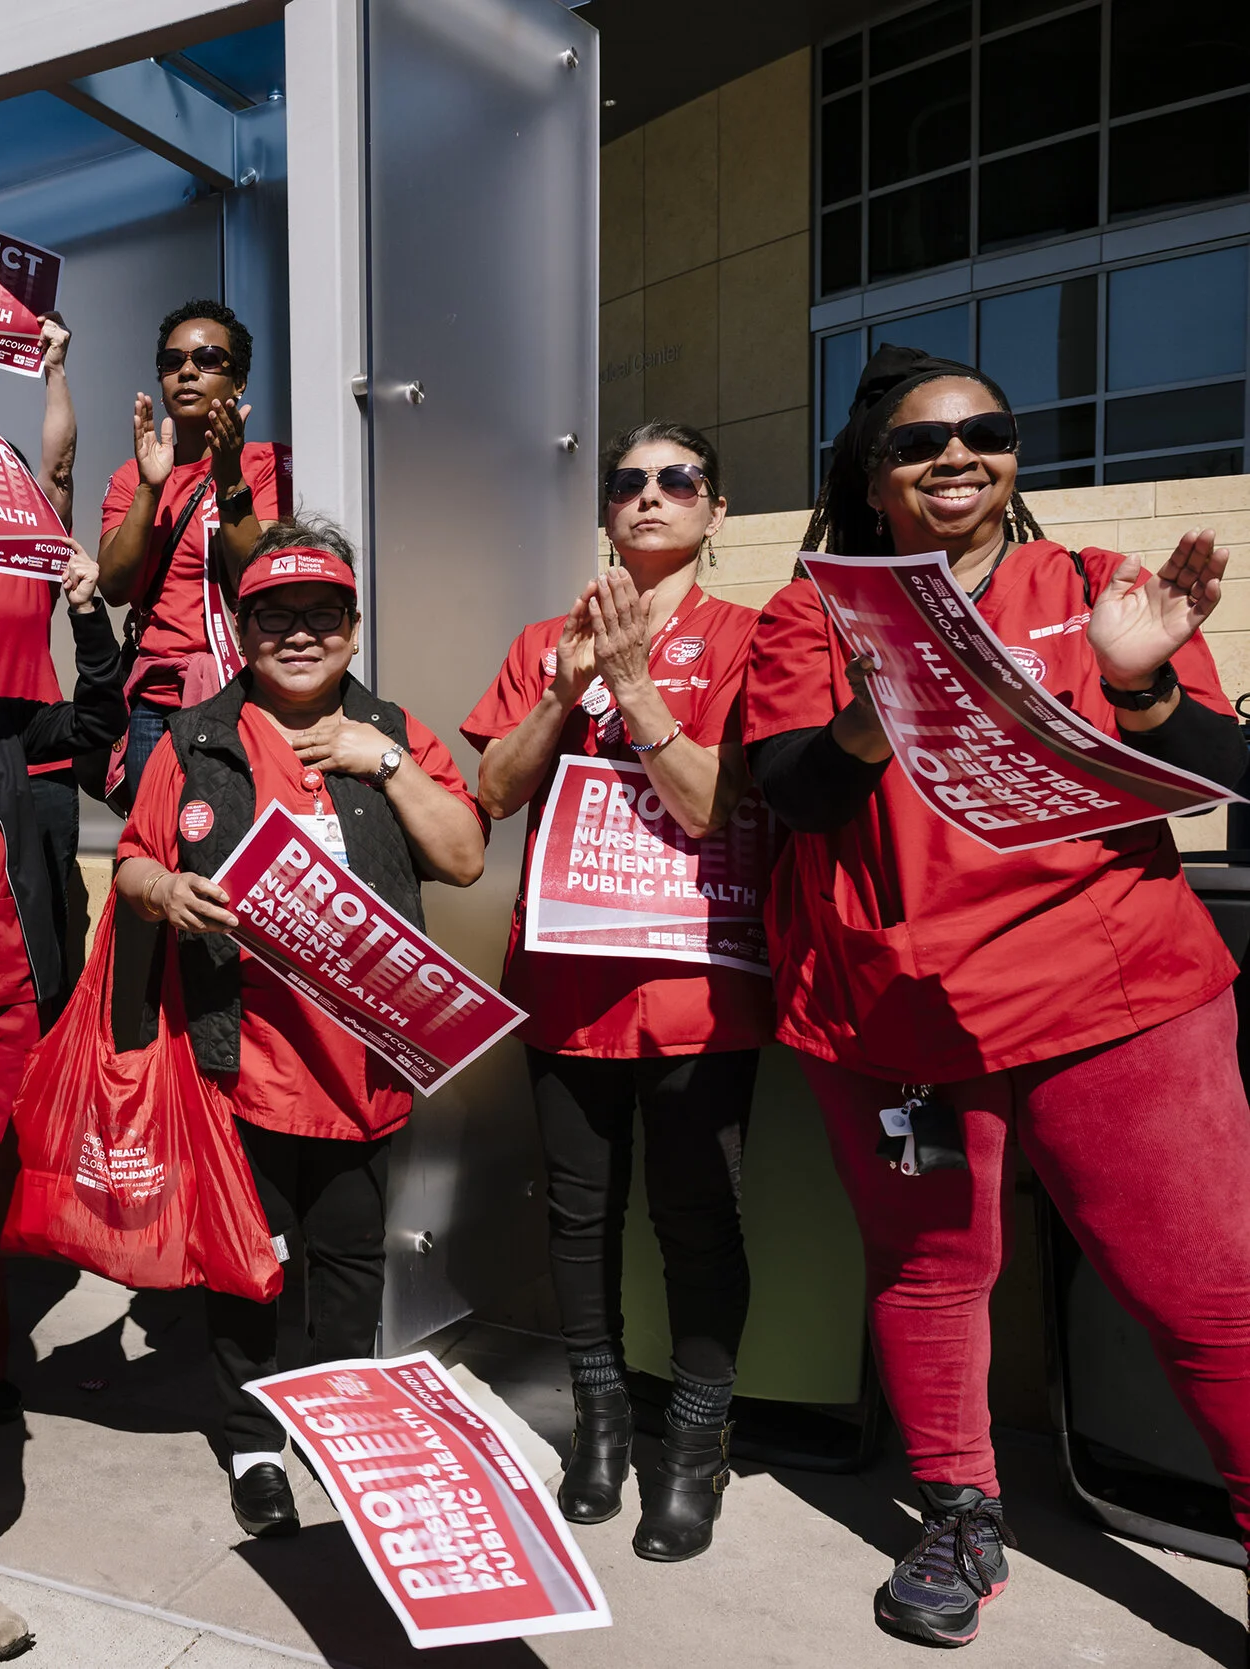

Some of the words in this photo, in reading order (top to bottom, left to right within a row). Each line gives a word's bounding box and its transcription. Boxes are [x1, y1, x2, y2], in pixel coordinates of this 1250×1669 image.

[35, 543, 74, 556] #COVID19
[911, 575, 968, 650] #COVID19
[914, 642, 1015, 746] HEALTH
[579, 778, 776, 834] PROCT
[947, 748, 1051, 822] NURSES
[952, 724, 1079, 817] PATIENTS
[1019, 751, 1122, 810] PUBLIC
[569, 849, 687, 876] PATIENTS
[572, 827, 665, 853] NURSES
[259, 869, 345, 947] NURSES
[276, 838, 486, 1007] PROTECT
[567, 872, 655, 897] PUBLIC
[664, 880, 757, 906] HEALTH
[236, 899, 316, 963] PUBLIC
[318, 961, 410, 1028] HEALTH
[247, 884, 354, 973] PATIENTS
[382, 1031, 436, 1073] #COVID19
[80, 1155, 110, 1175] GLOBA
[110, 1163, 164, 1181] SOLIDARITY
[82, 1144, 106, 1160] GLOB
[109, 1157, 149, 1169] JUSTICE
[109, 1147, 146, 1157] HEALTH
[392, 1408, 470, 1481] HEALTH
[283, 1394, 446, 1600] PROTECT
[419, 1463, 504, 1590] PATIENTS
[408, 1483, 474, 1593] NURSES
[459, 1487, 528, 1587] PUBLIC
